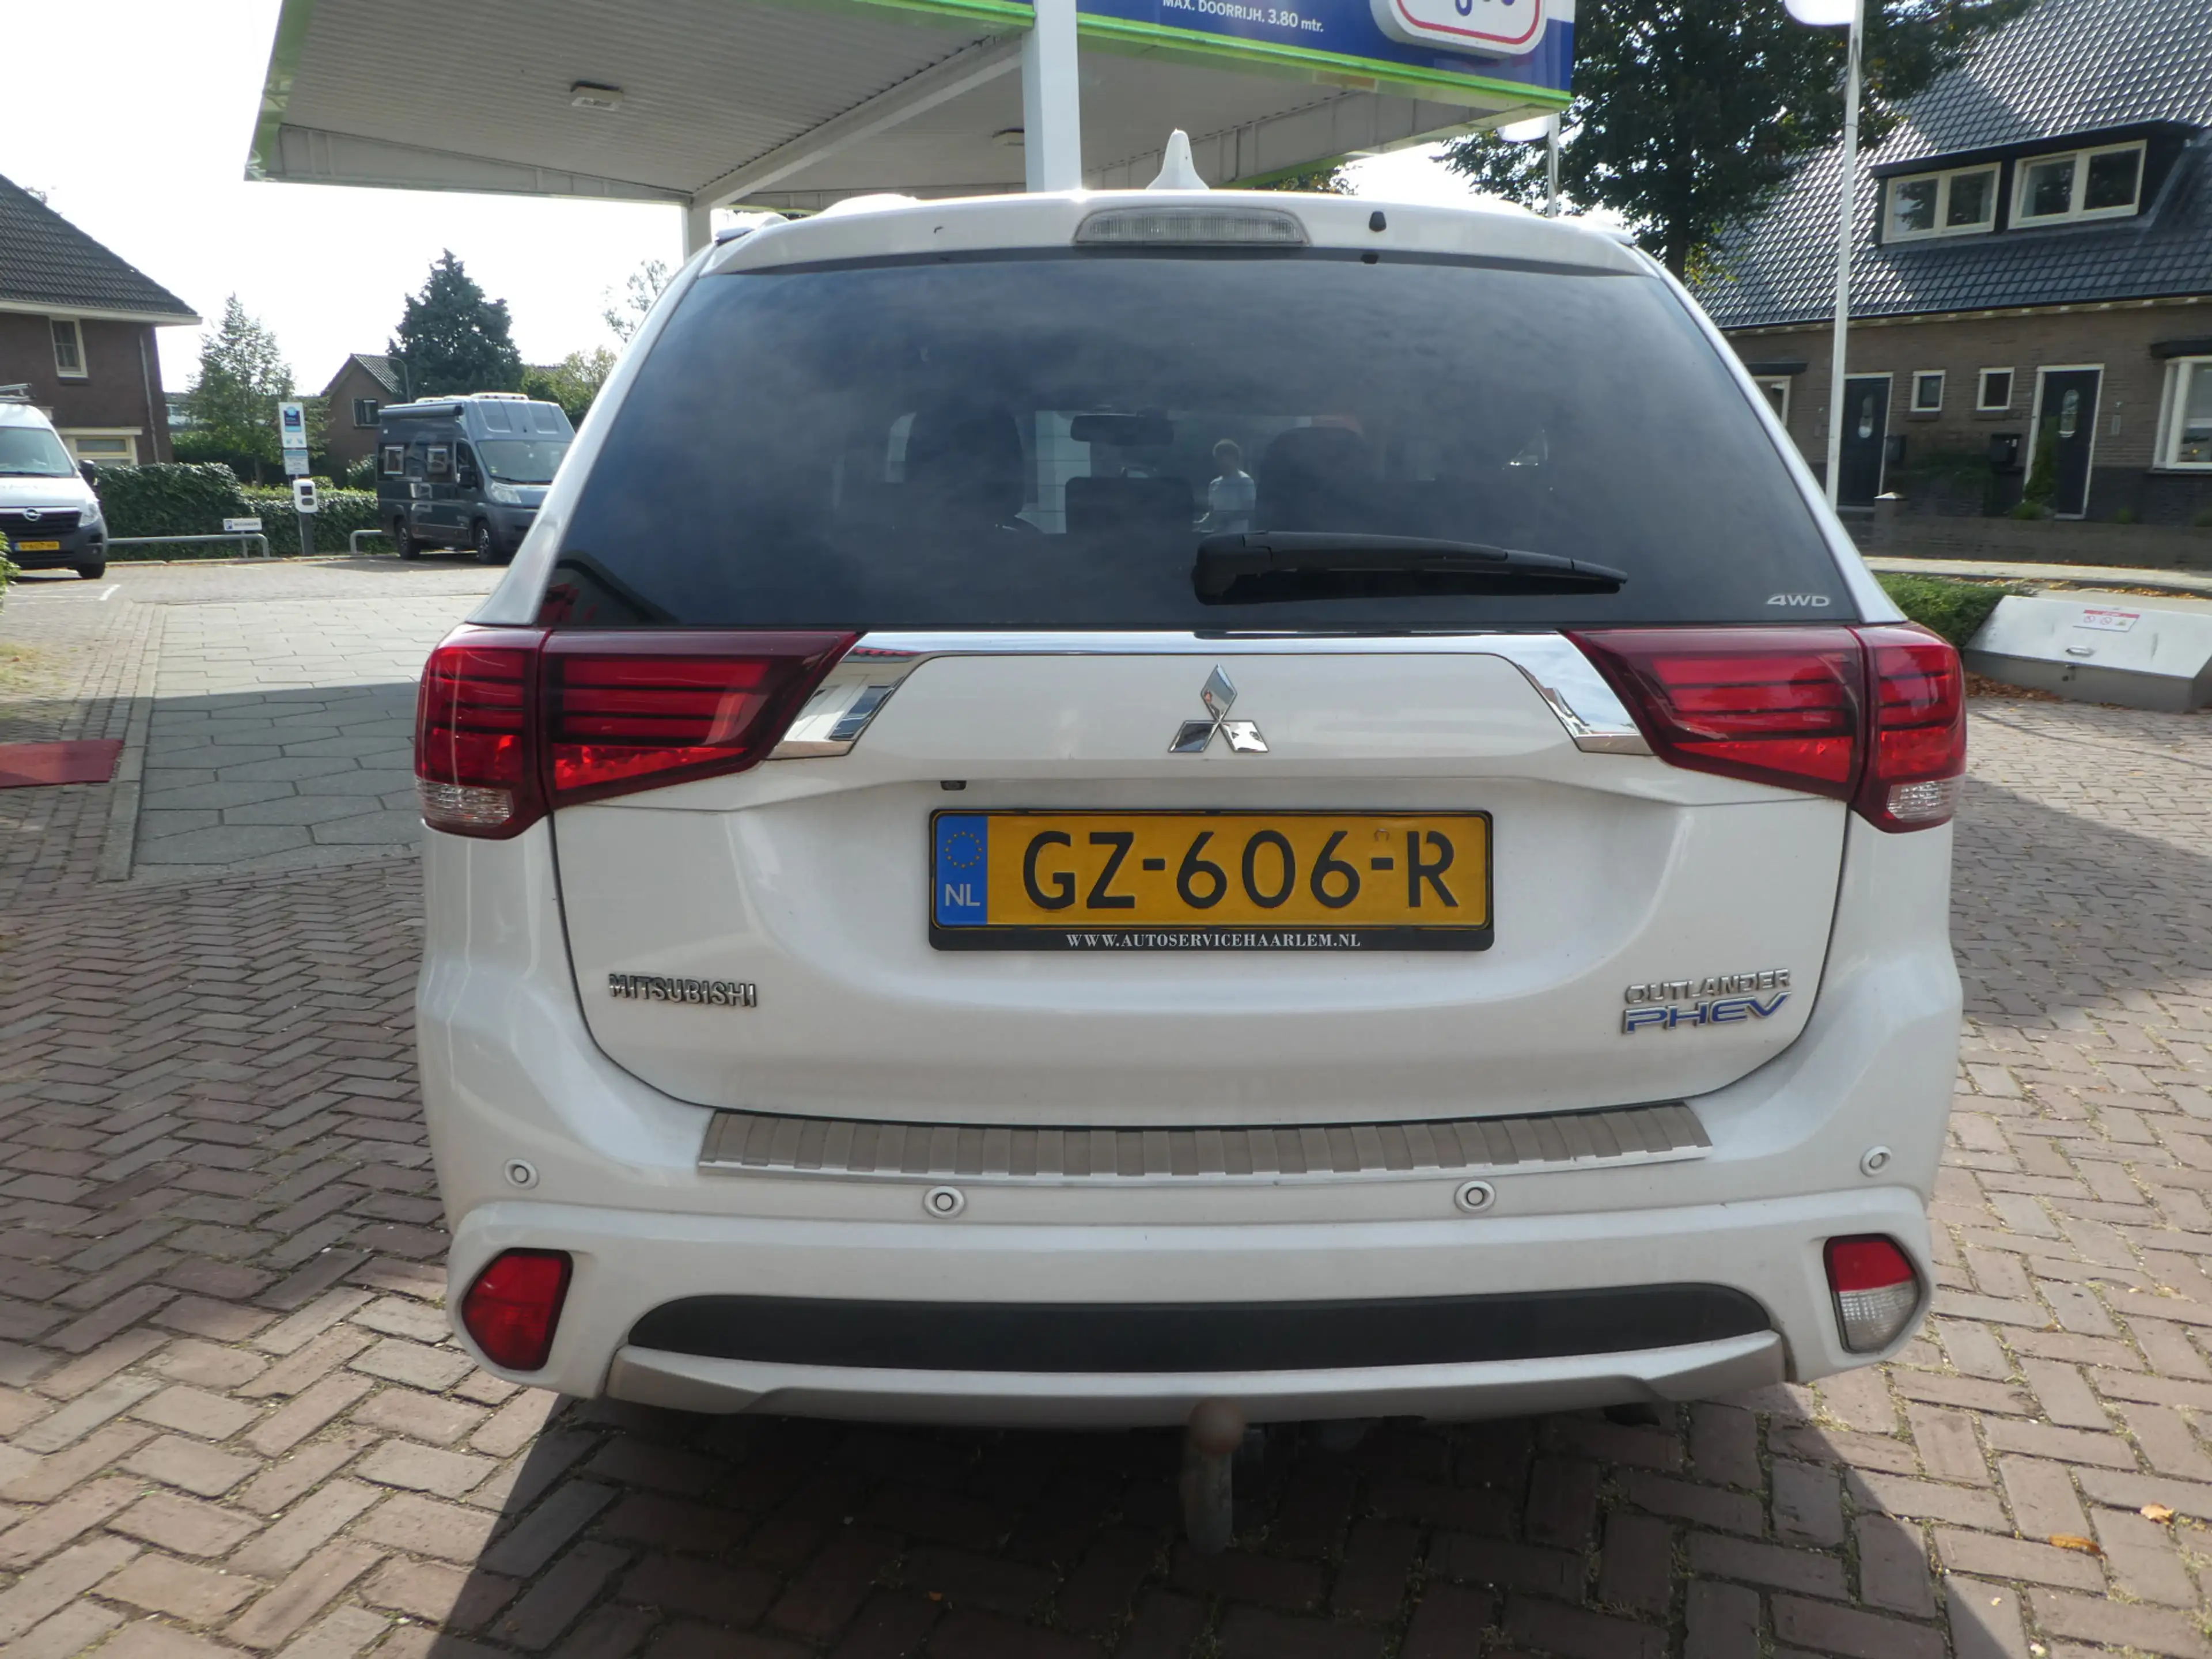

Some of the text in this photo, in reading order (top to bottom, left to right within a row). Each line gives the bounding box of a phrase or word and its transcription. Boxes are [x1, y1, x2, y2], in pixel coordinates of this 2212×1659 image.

[1198, 0, 1265, 22] DOORRIJH.
[1268, 9, 1298, 28] 3.80
[1301, 18, 1324, 32] mtr.
[1767, 594, 1830, 607] 4WD
[1023, 830, 1459, 910] GZ-606-R
[945, 883, 981, 907] NL
[1066, 933, 1361, 947] WWW.AUTOSERVICEHAARLEM.NL
[608, 973, 757, 1007] MITSUBISHI
[1624, 968, 1790, 1005] OUTLANDER
[1622, 990, 1792, 1035] PHEV
